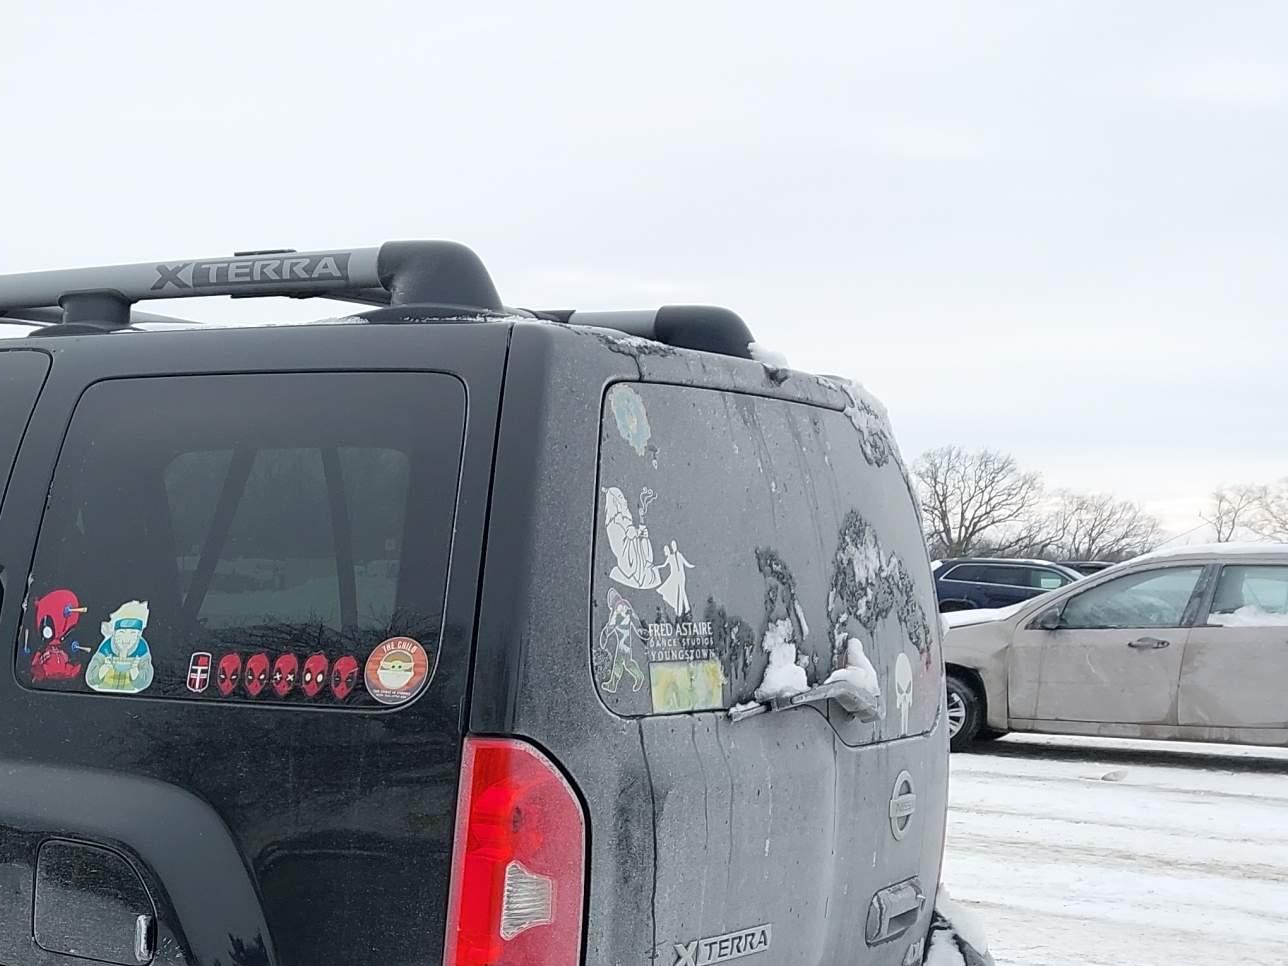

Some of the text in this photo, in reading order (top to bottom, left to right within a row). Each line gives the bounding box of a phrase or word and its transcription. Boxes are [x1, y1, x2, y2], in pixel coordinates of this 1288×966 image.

[150, 255, 345, 290] XTERRA
[649, 621, 713, 637] FRED ASTAIRE
[382, 641, 395, 654] THE
[649, 637, 677, 648] DANCE
[651, 648, 717, 661] YOUNGSTOWN
